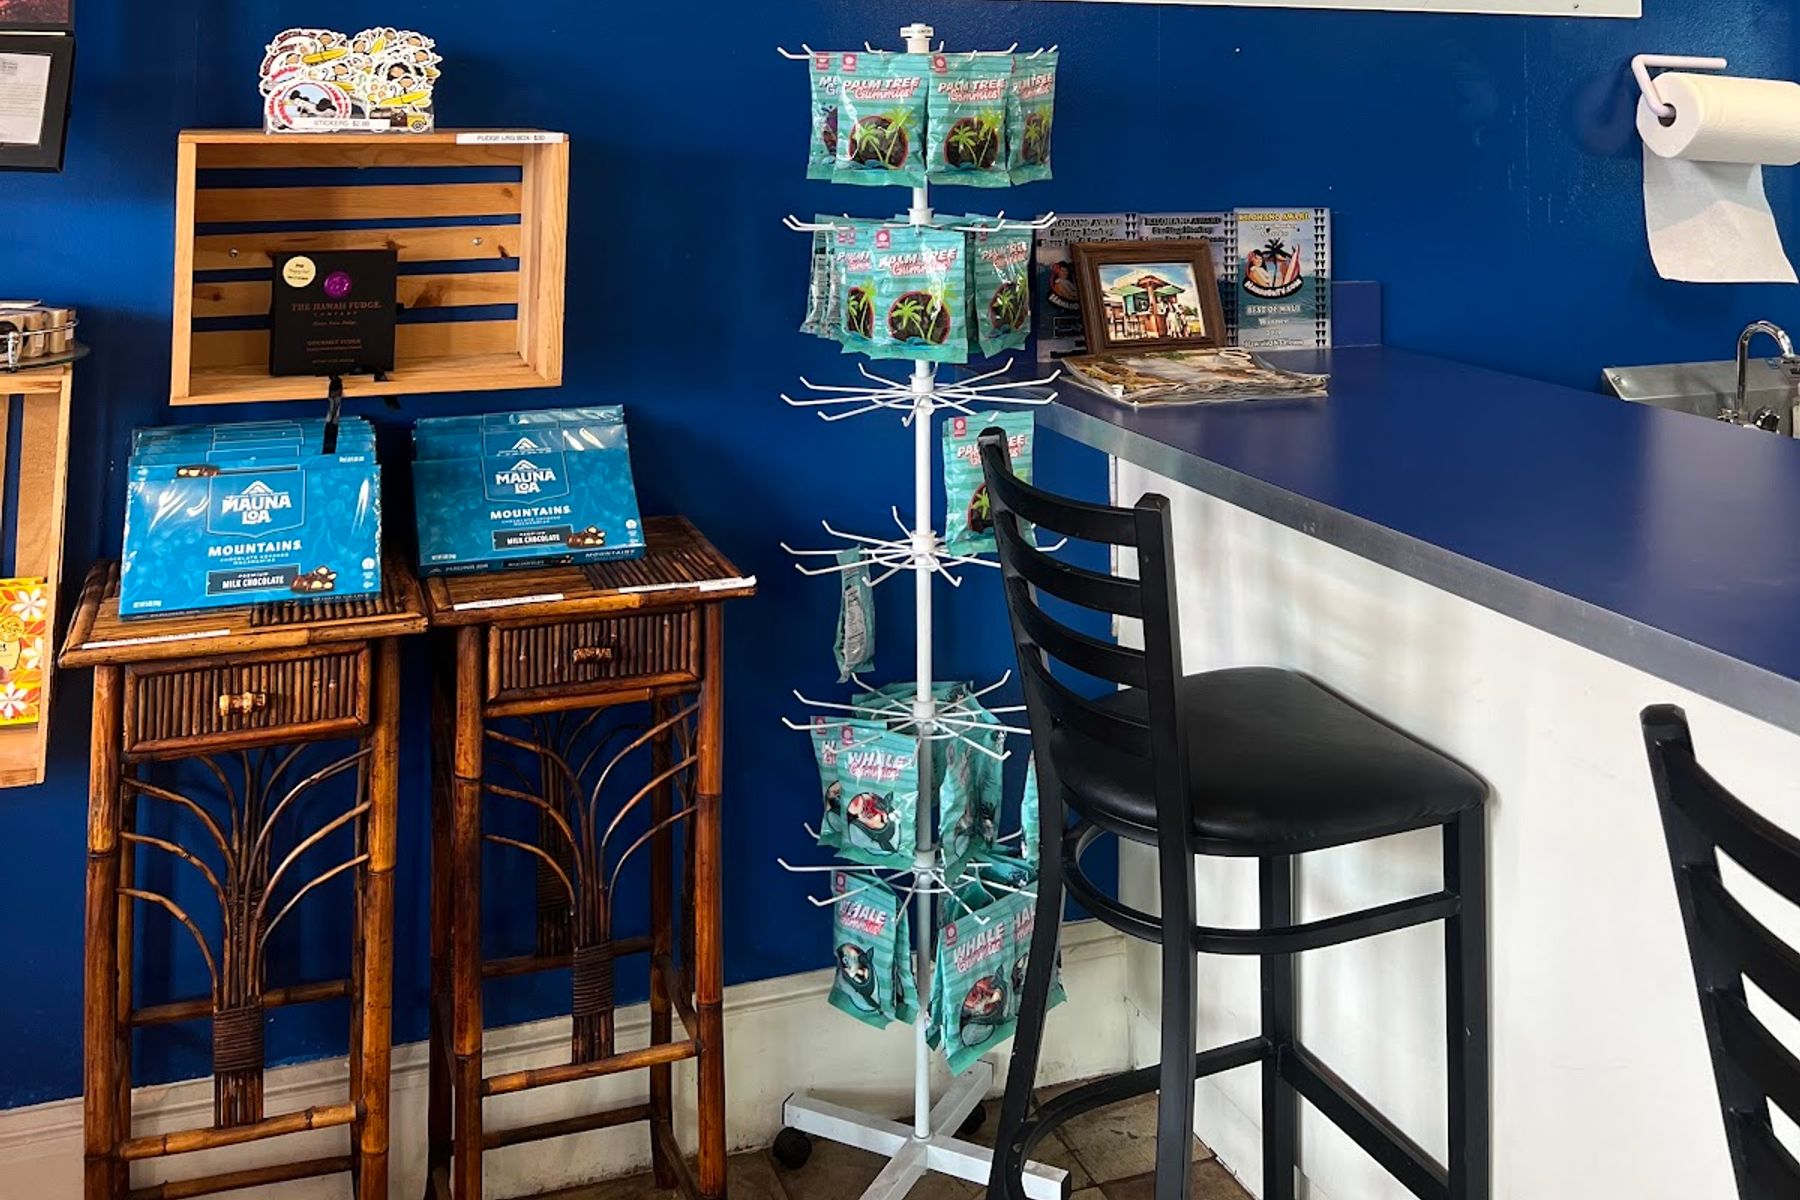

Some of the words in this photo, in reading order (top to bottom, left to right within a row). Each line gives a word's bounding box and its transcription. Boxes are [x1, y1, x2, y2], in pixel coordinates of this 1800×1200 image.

[885, 76, 921, 88] TREE
[972, 78, 1006, 90] TREE
[291, 303, 311, 312] THE
[494, 470, 557, 485] MAUNA
[514, 481, 542, 495] LOA
[222, 494, 292, 514] MAUNA
[241, 509, 273, 525] LOA
[490, 505, 572, 521] MOUNTAINS
[524, 533, 561, 545] CHOCOLATE
[207, 539, 302, 558] MOUNTAINS
[222, 579, 241, 589] MILK
[242, 575, 285, 588] CHOCOLATE
[847, 751, 908, 769] WHALE
[953, 921, 1006, 963] WHALE
